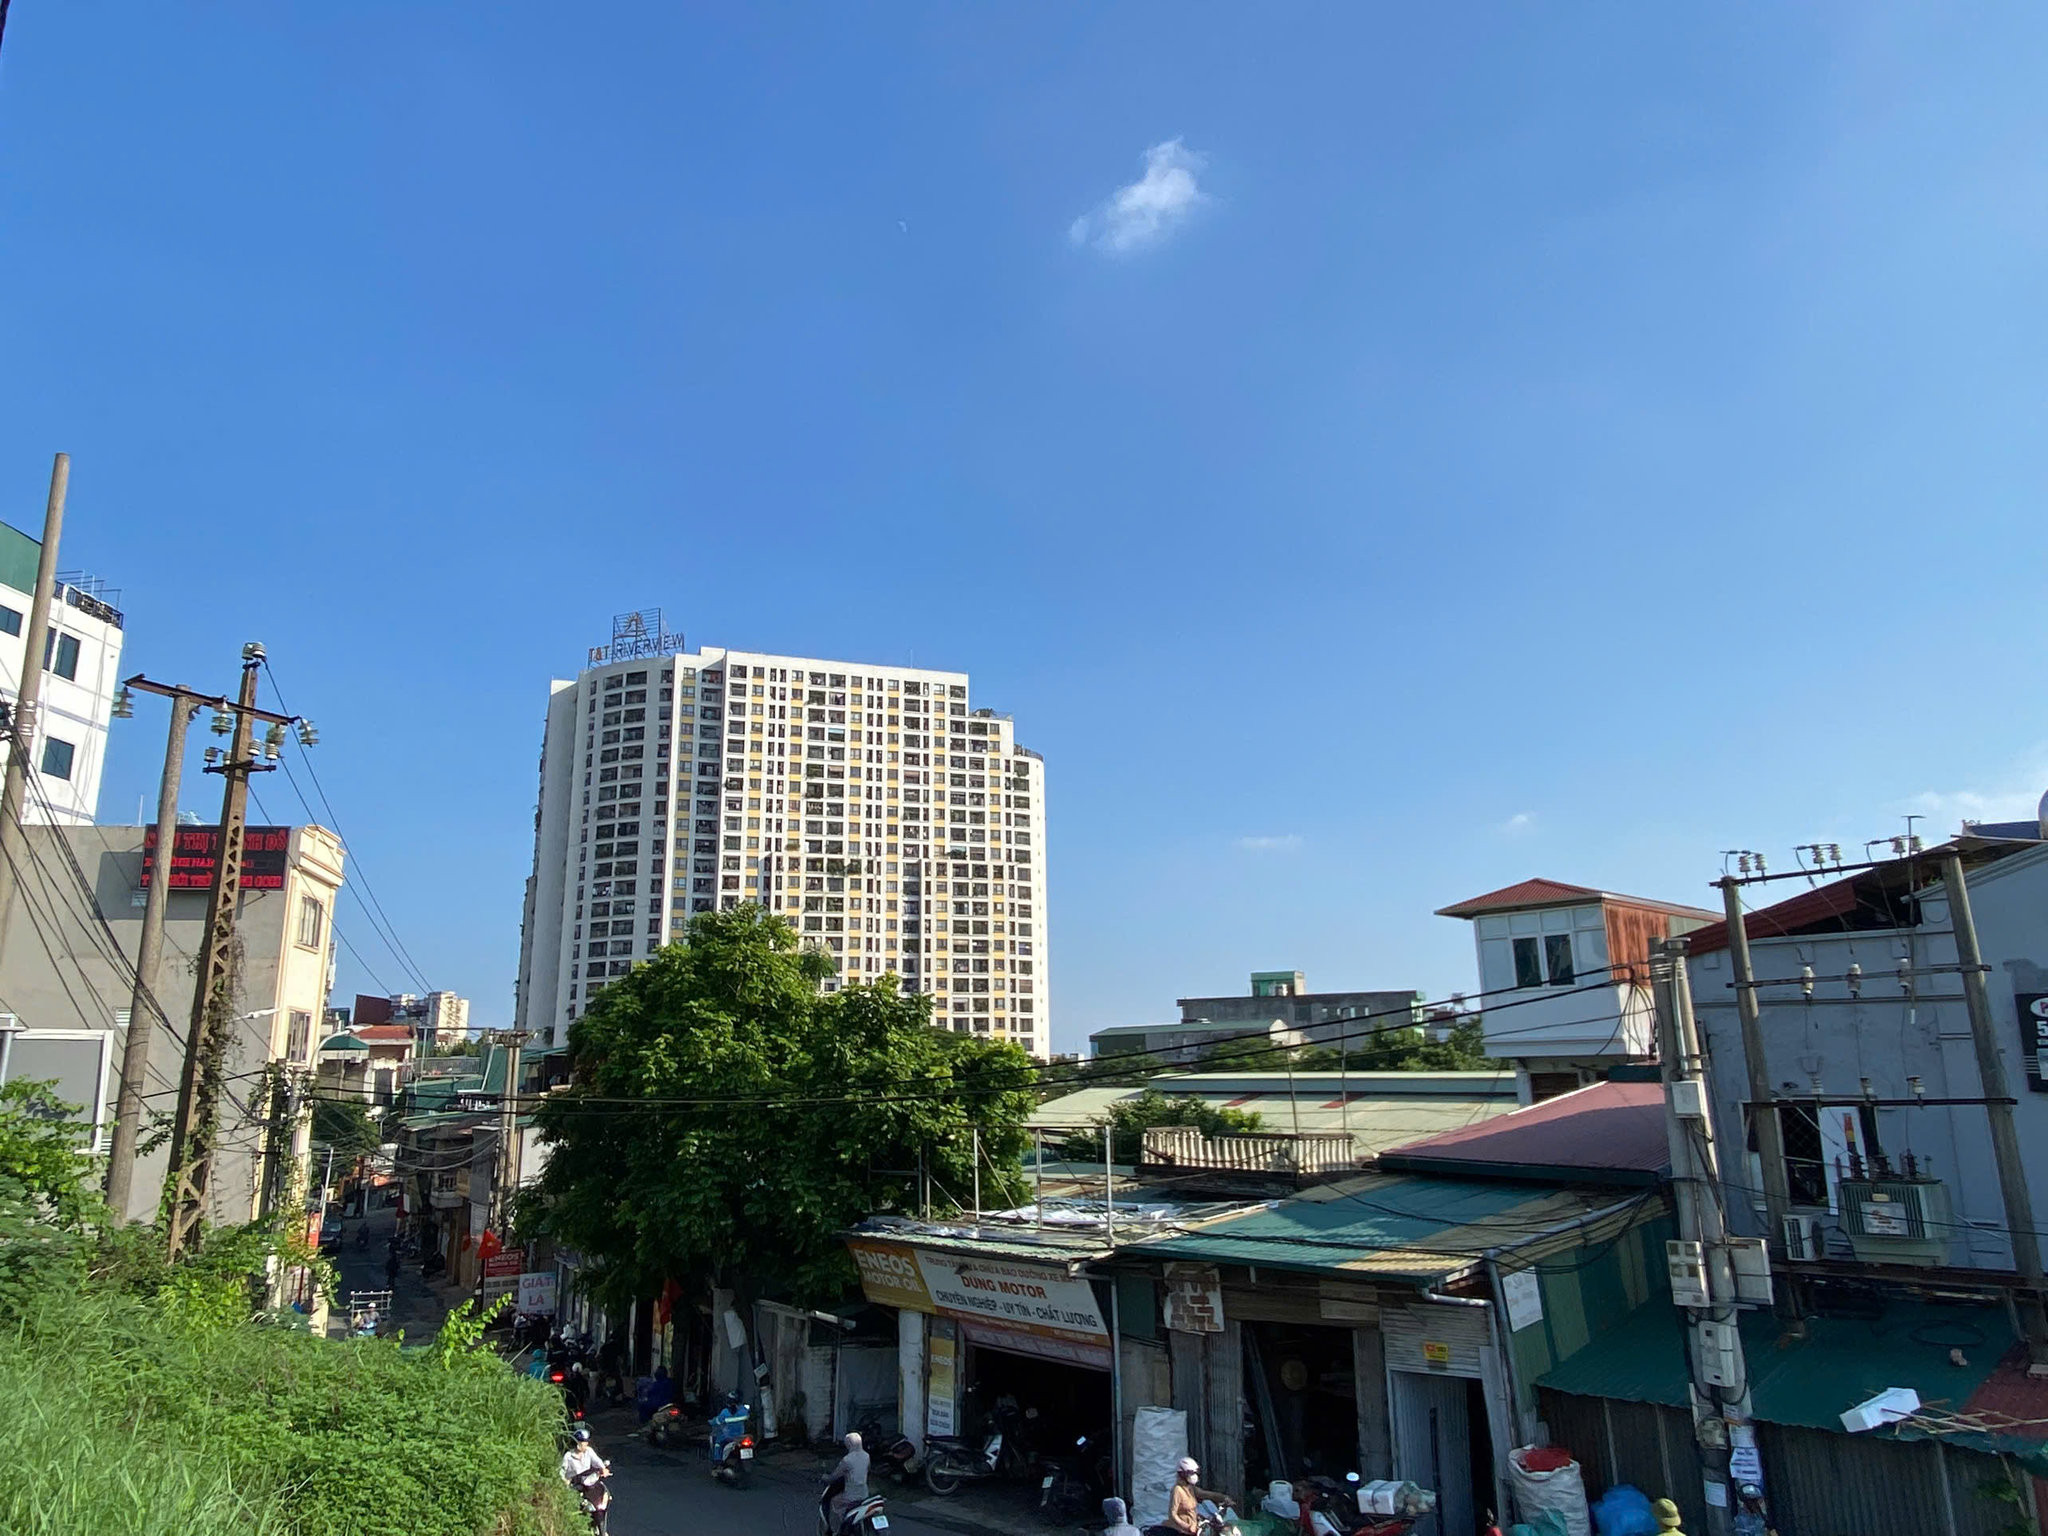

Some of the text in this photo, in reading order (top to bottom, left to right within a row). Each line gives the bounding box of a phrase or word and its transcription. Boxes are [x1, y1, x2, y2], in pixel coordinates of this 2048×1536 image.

[616, 632, 684, 657] RIVERVIEW
[854, 1249, 916, 1277] ENEOS
[862, 1270, 923, 1293] MOTOR OIL
[997, 1280, 1048, 1299] MOTOR
[936, 1290, 968, 1306] CHUYÊN
[1002, 1301, 1014, 1314] UY
[1014, 1301, 1031, 1318] TÍN
[1035, 1304, 1060, 1322] CHẤT
